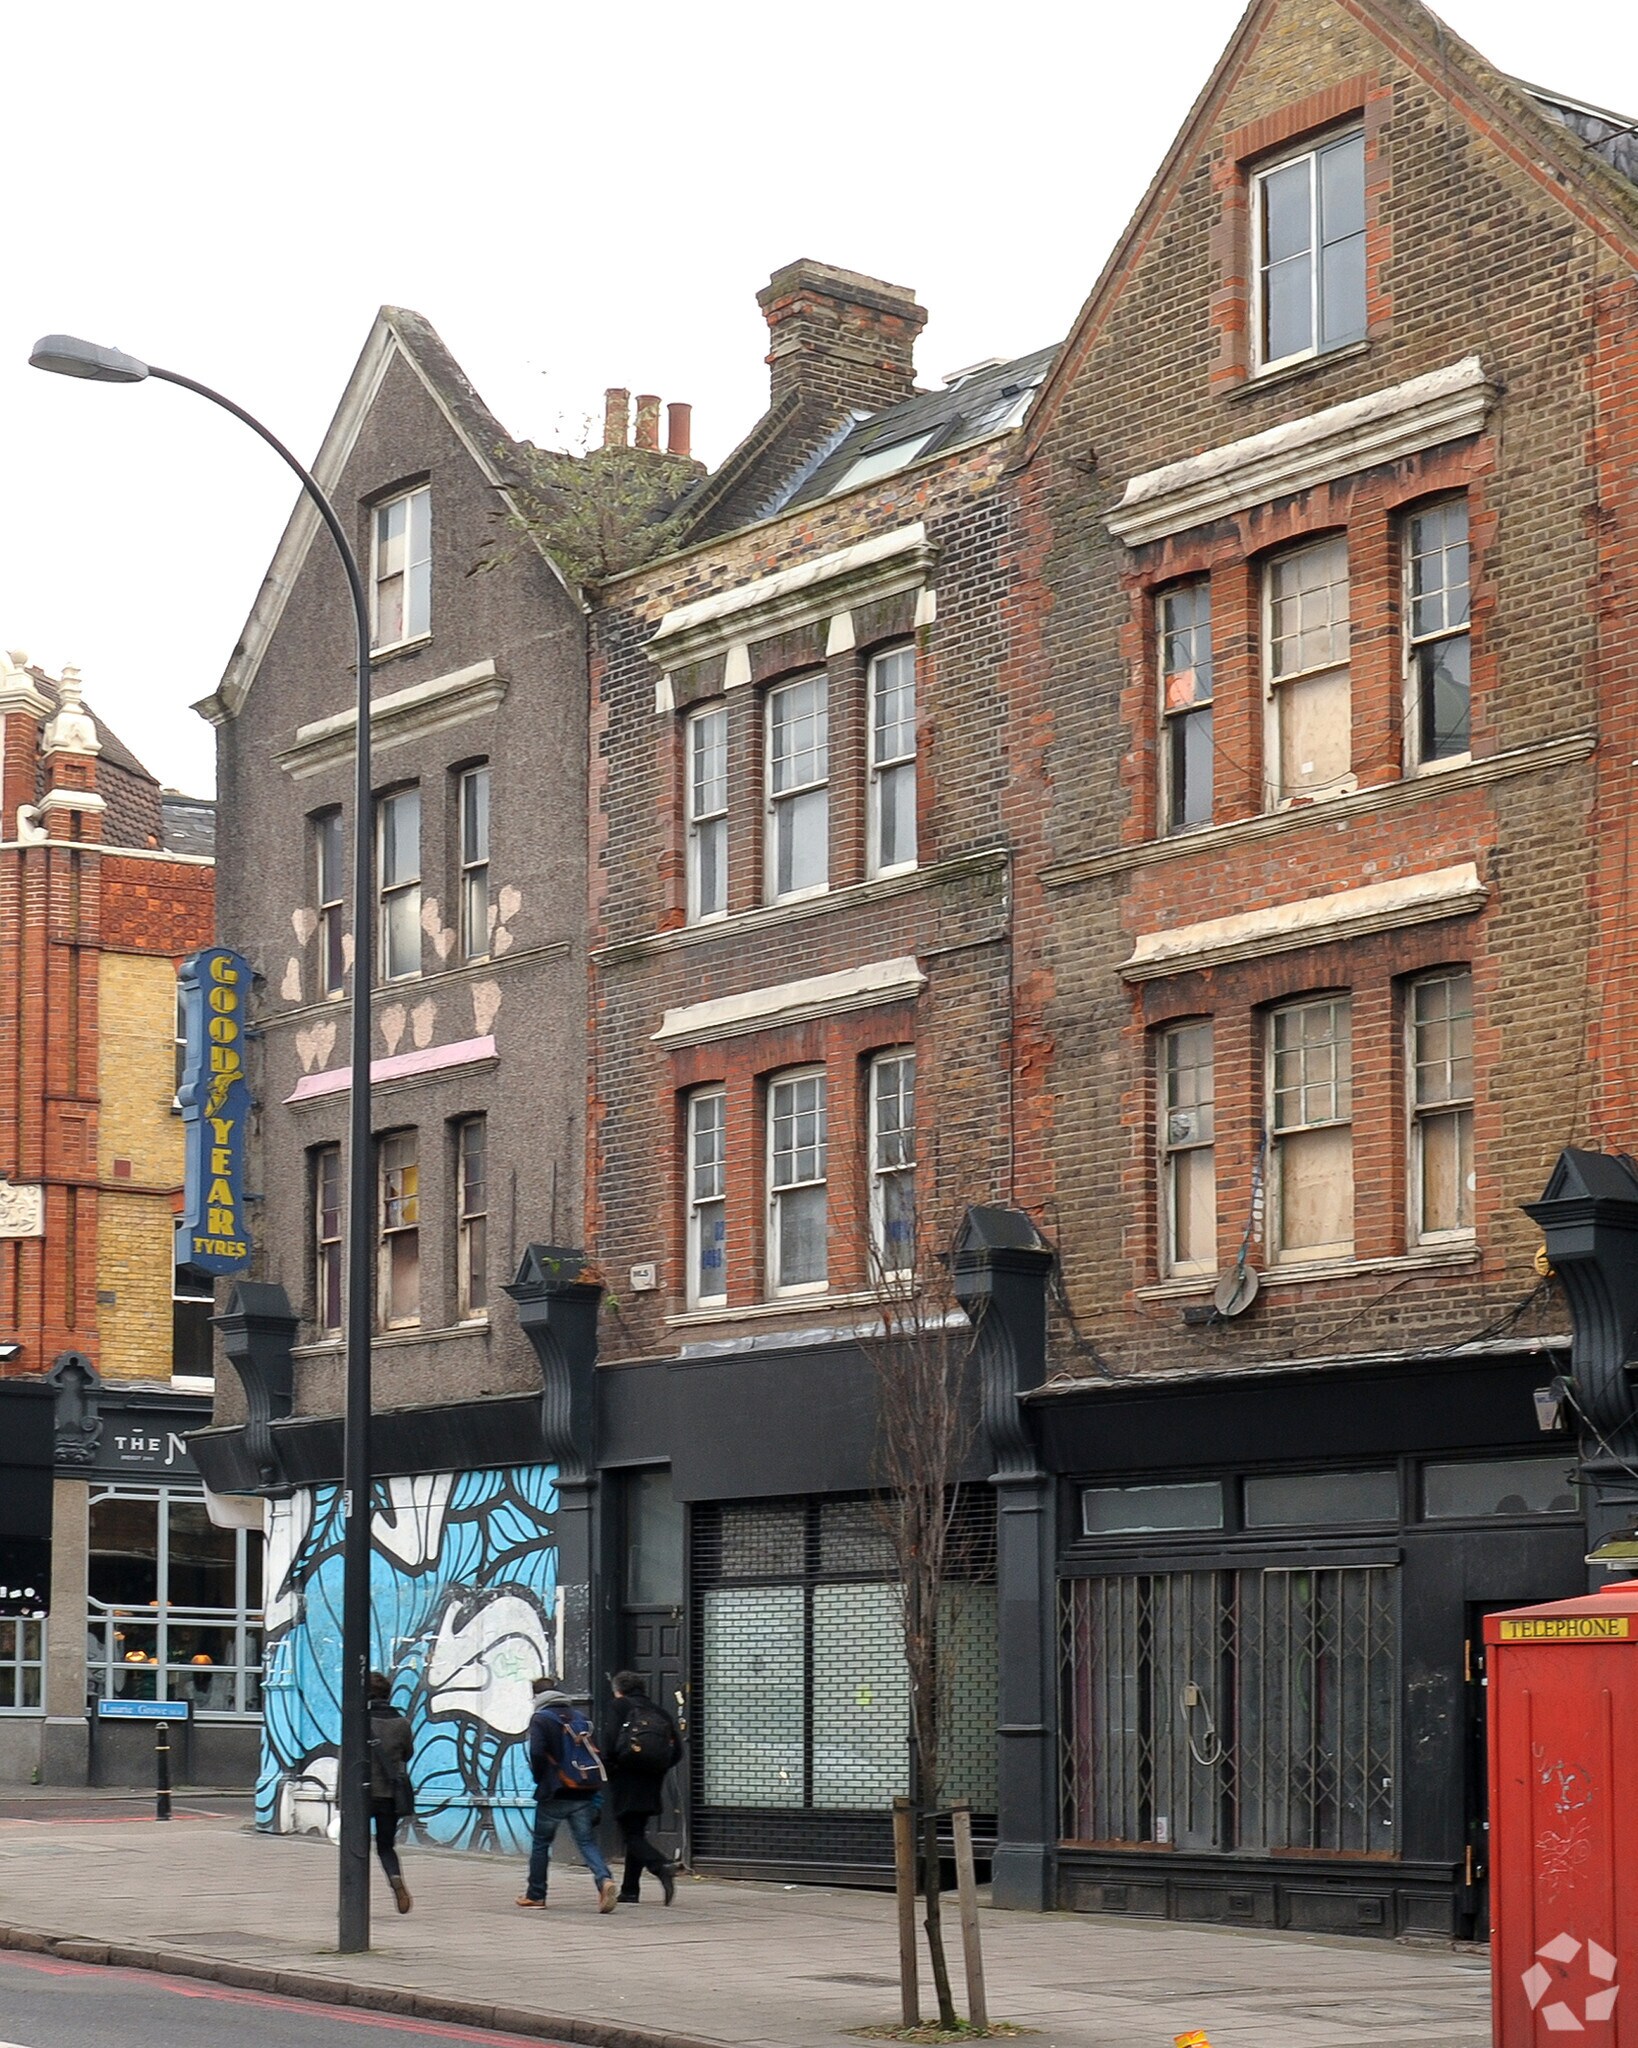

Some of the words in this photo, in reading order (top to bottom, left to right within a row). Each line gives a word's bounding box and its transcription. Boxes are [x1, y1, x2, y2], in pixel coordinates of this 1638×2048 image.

[192, 1237, 247, 1260] TYRES
[114, 1436, 161, 1452] THE
[1509, 1618, 1620, 1638] TELEPHONE
